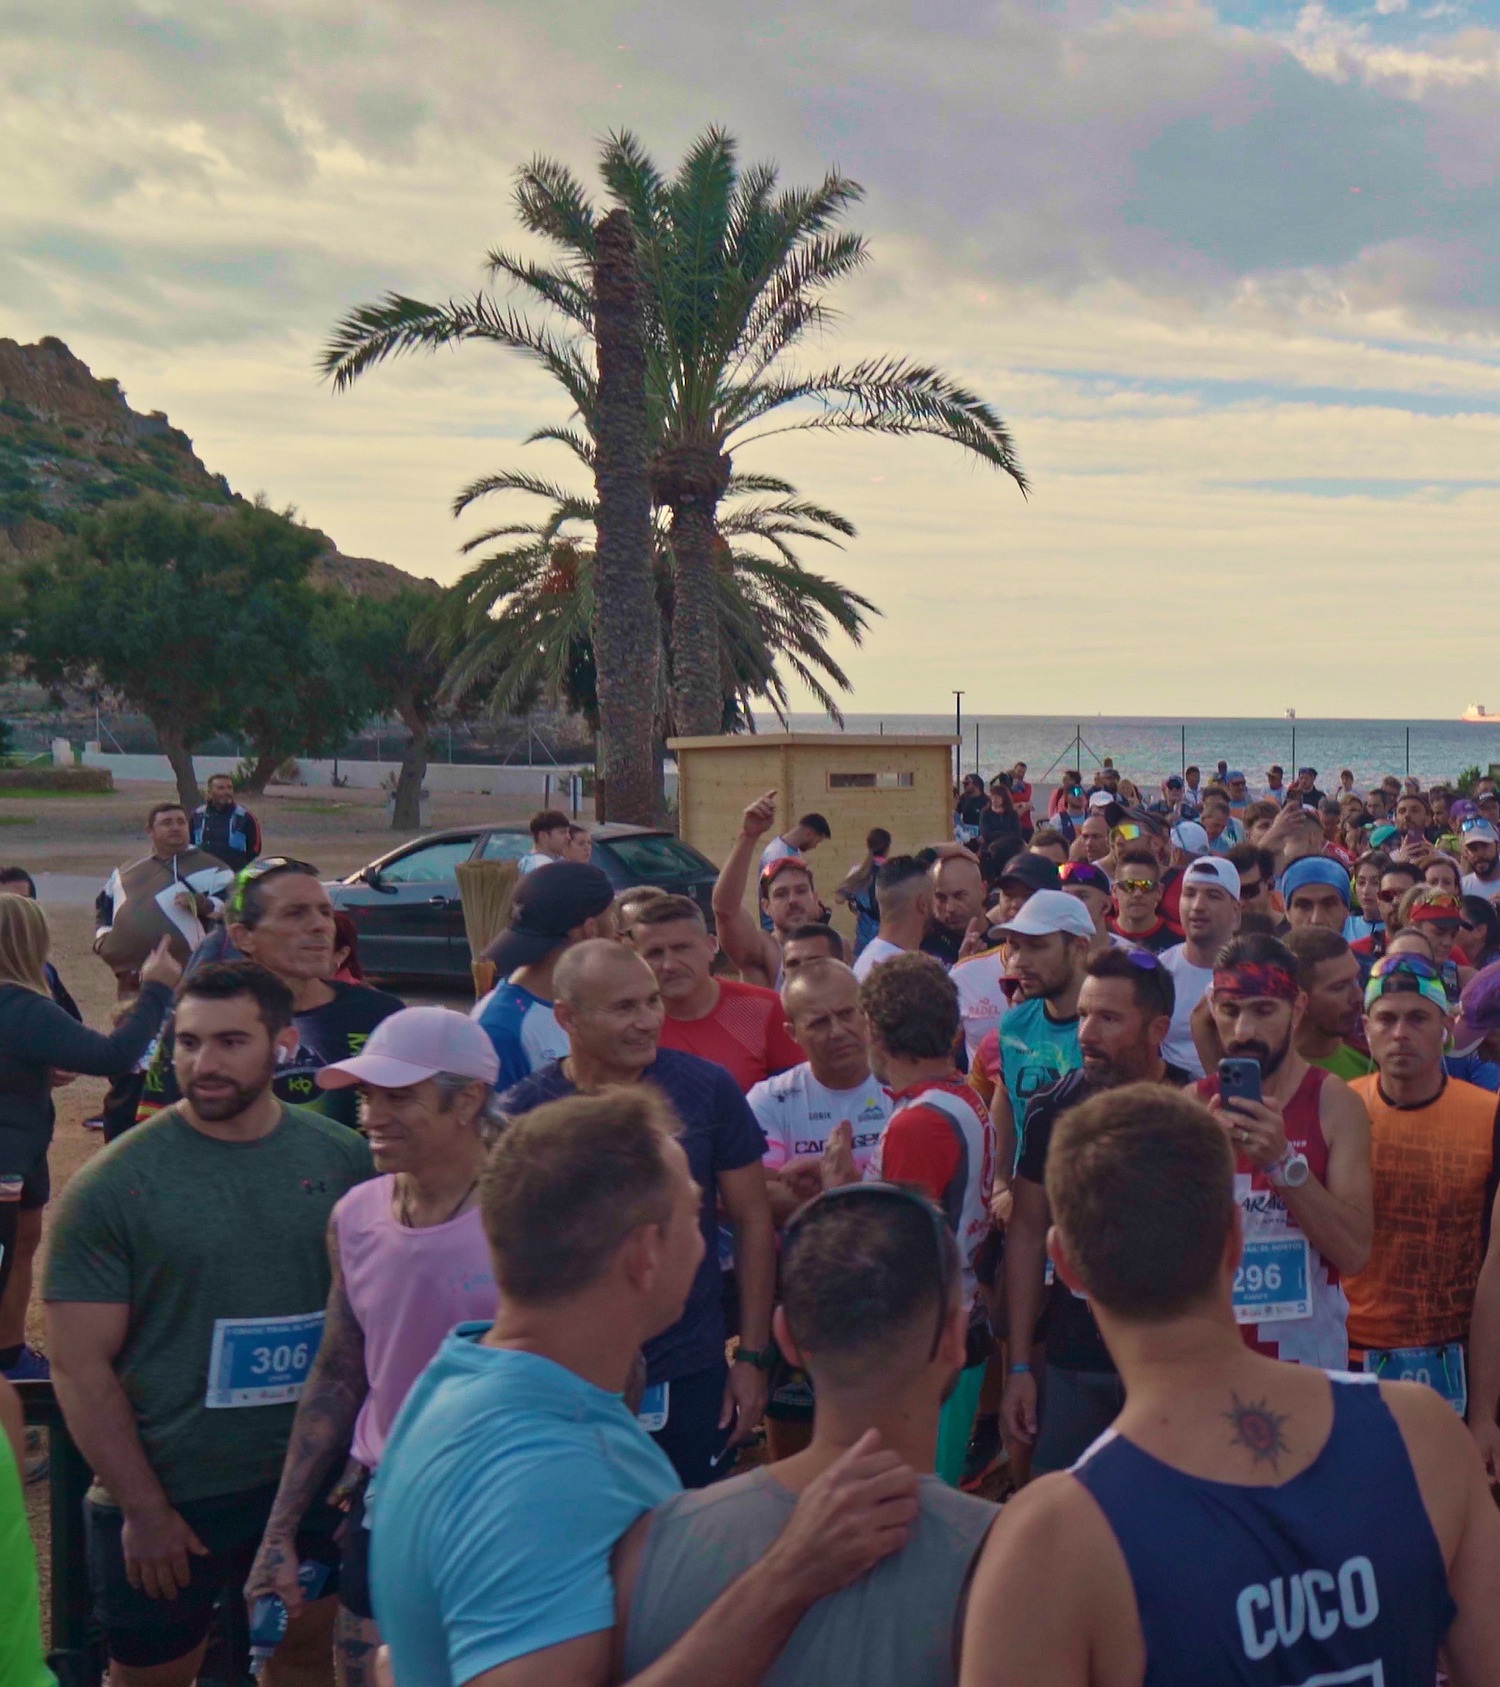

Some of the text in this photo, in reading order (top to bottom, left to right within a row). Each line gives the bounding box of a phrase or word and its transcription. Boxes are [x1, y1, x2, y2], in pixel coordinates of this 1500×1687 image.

[1234, 1263, 1282, 1292] 296
[251, 1343, 308, 1374] 306
[1236, 1555, 1380, 1661] CUCO
